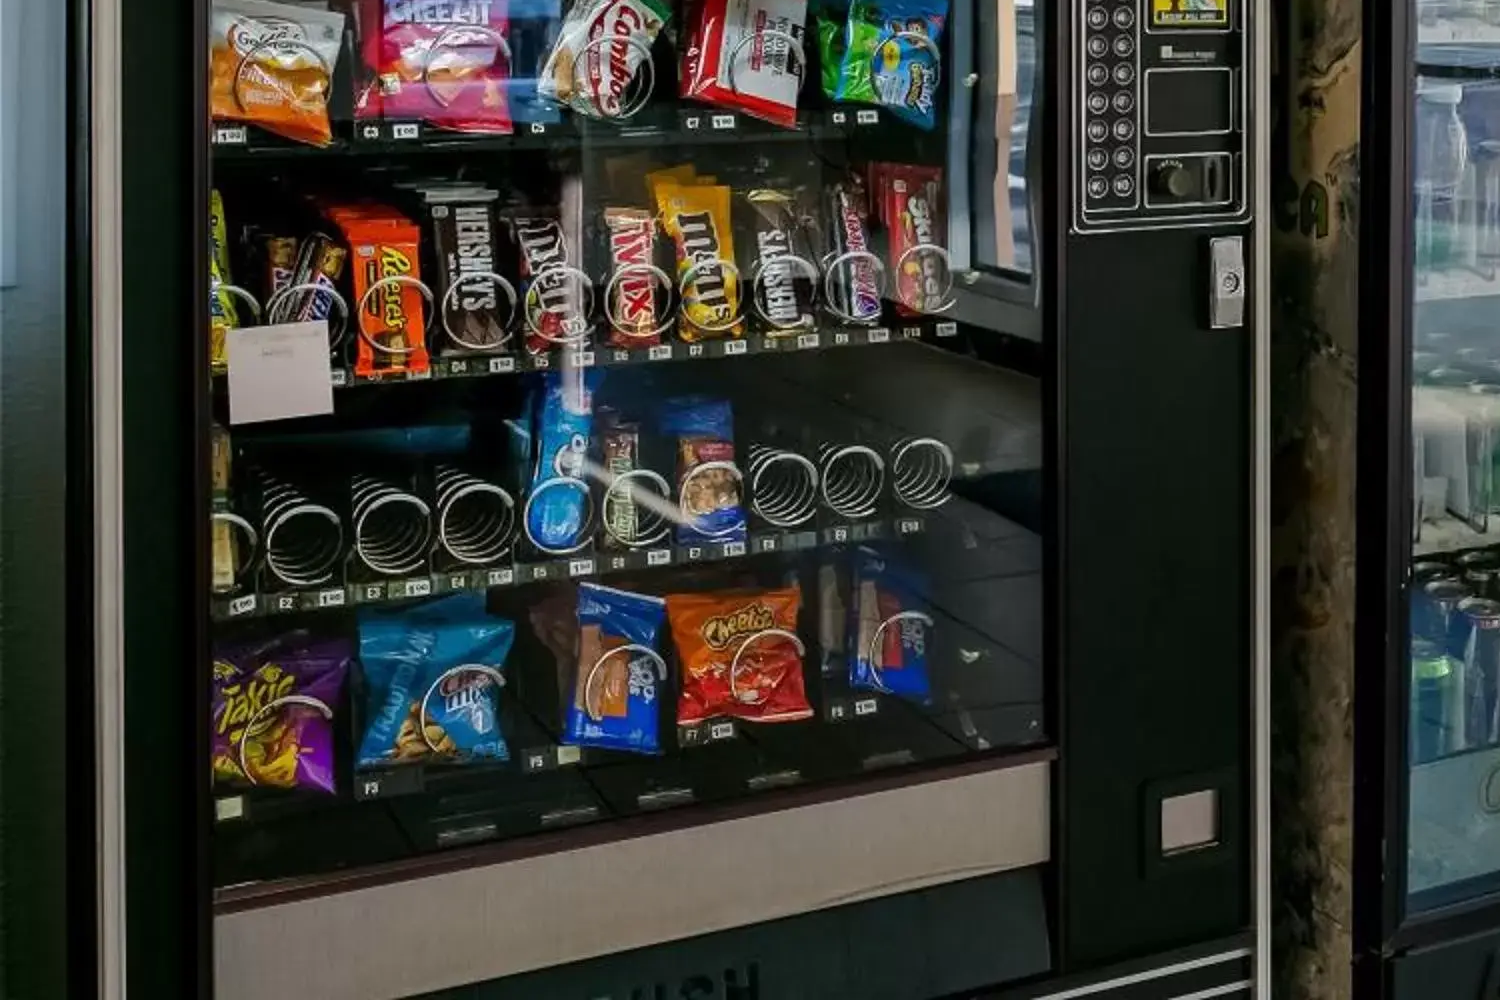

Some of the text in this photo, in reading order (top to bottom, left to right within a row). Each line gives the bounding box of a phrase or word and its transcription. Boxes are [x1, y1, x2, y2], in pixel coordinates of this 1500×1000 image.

[607, 5, 641, 111] Combos
[381, 245, 411, 329] Reese's
[455, 206, 497, 311] HERSHEY'S
[703, 601, 776, 651] Cheetos
